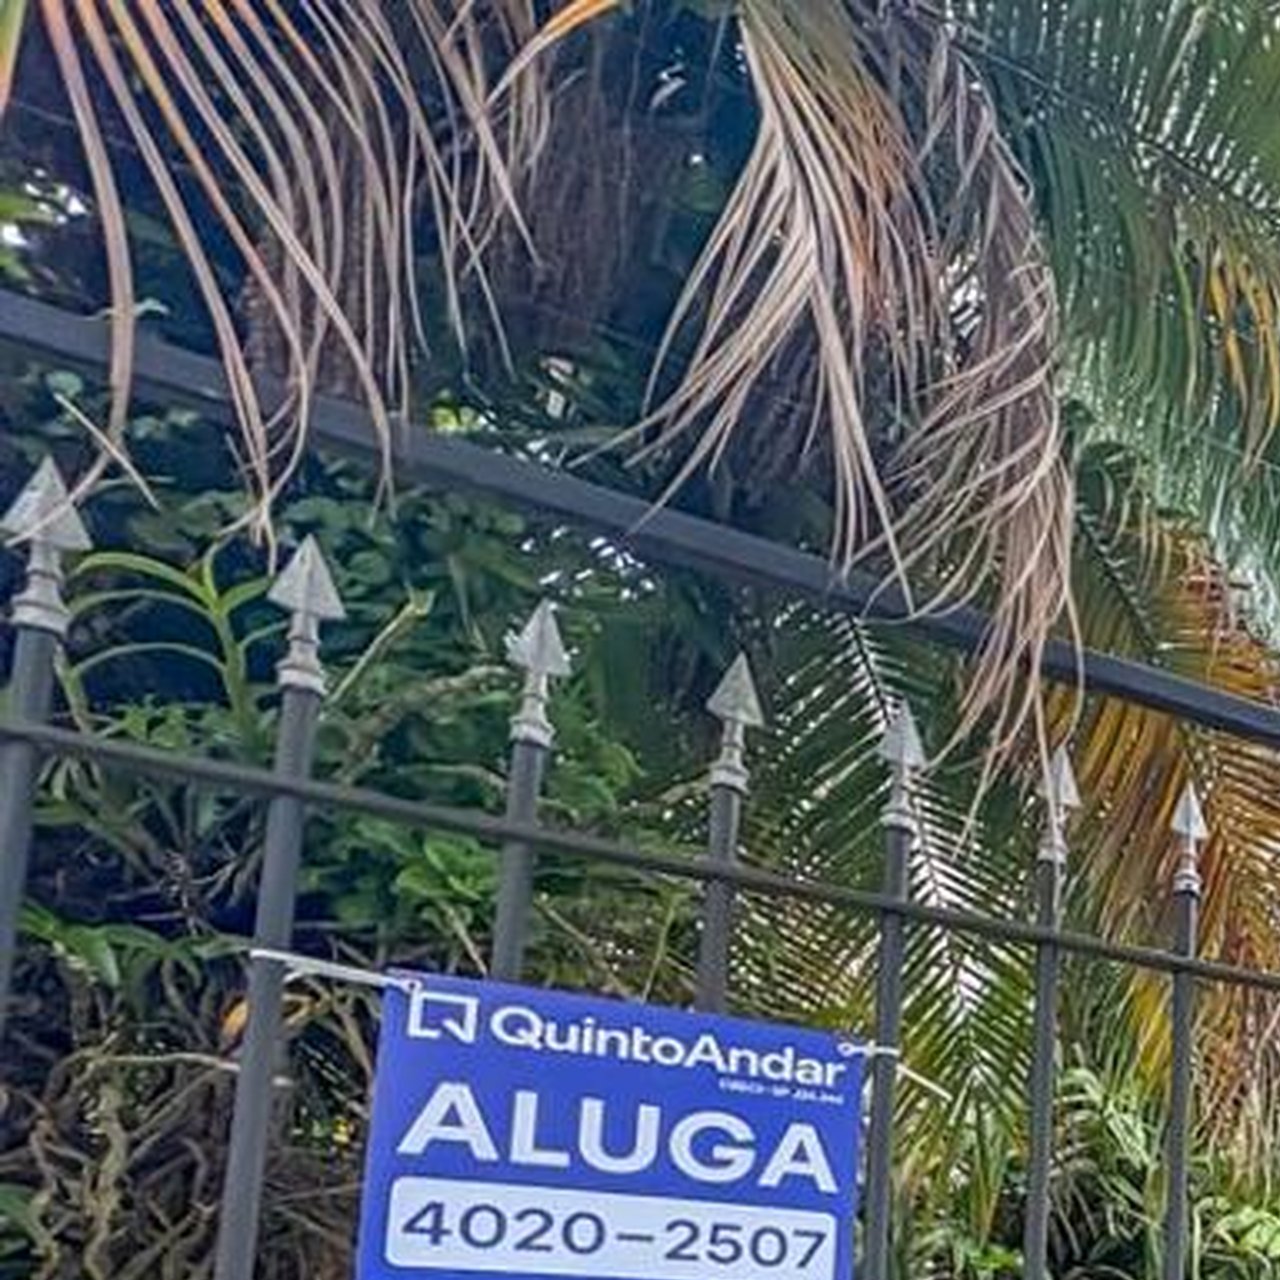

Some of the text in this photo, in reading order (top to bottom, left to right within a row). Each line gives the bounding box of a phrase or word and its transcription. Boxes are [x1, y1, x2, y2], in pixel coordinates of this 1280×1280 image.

[490, 1006, 846, 1087] QuintoAndar
[396, 1081, 839, 1194] ALUGA
[401, 1201, 828, 1269] 4020-2507
